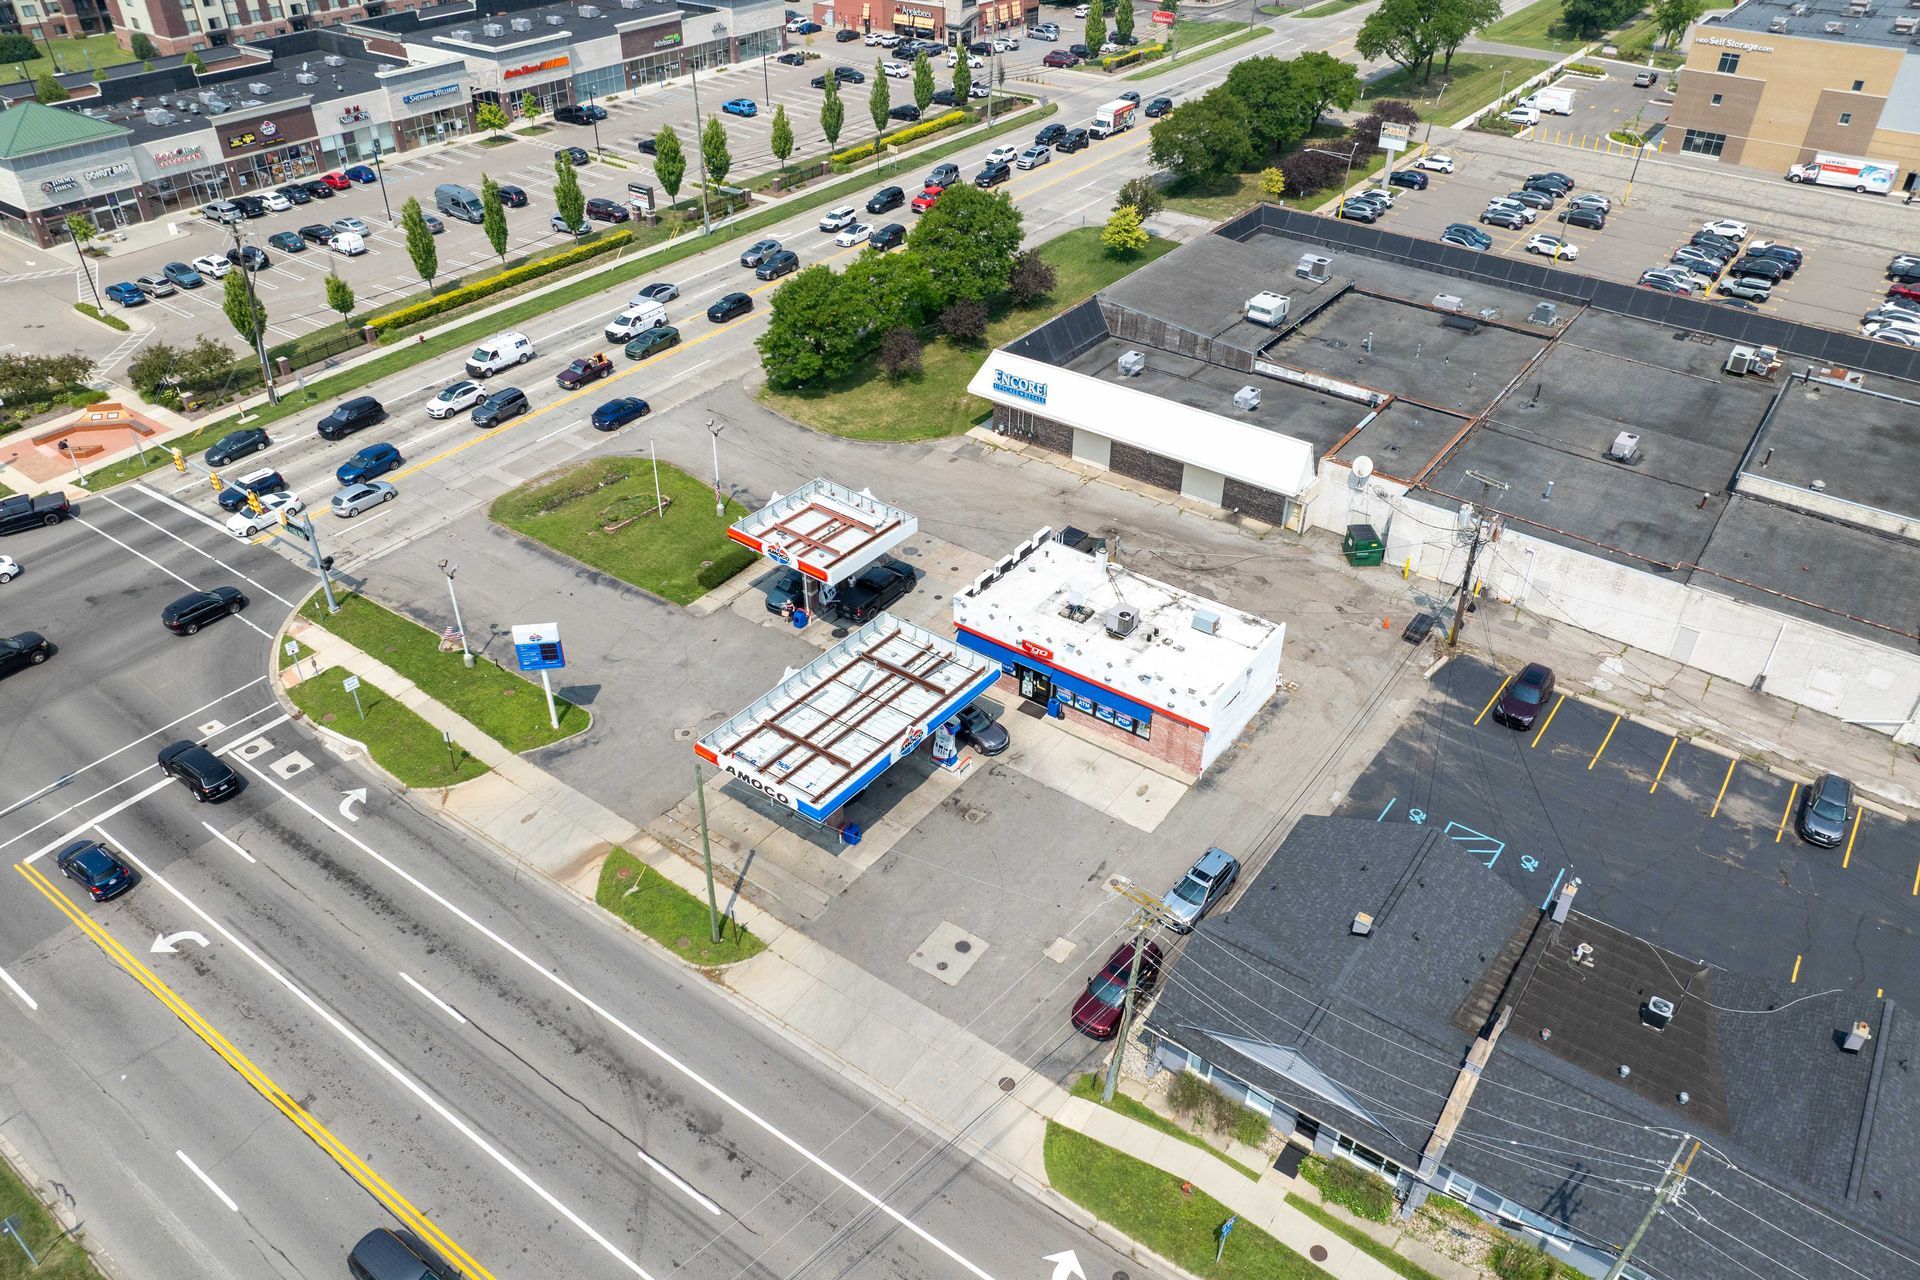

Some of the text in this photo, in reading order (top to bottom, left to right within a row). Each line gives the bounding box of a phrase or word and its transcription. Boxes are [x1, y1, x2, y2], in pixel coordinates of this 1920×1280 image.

[994, 368, 1048, 398] ENCORE!
[1078, 701, 1091, 709] ATM
[1117, 717, 1130, 725] POP
[900, 731, 924, 752] AMOCO
[725, 765, 789, 805] AMOCO
